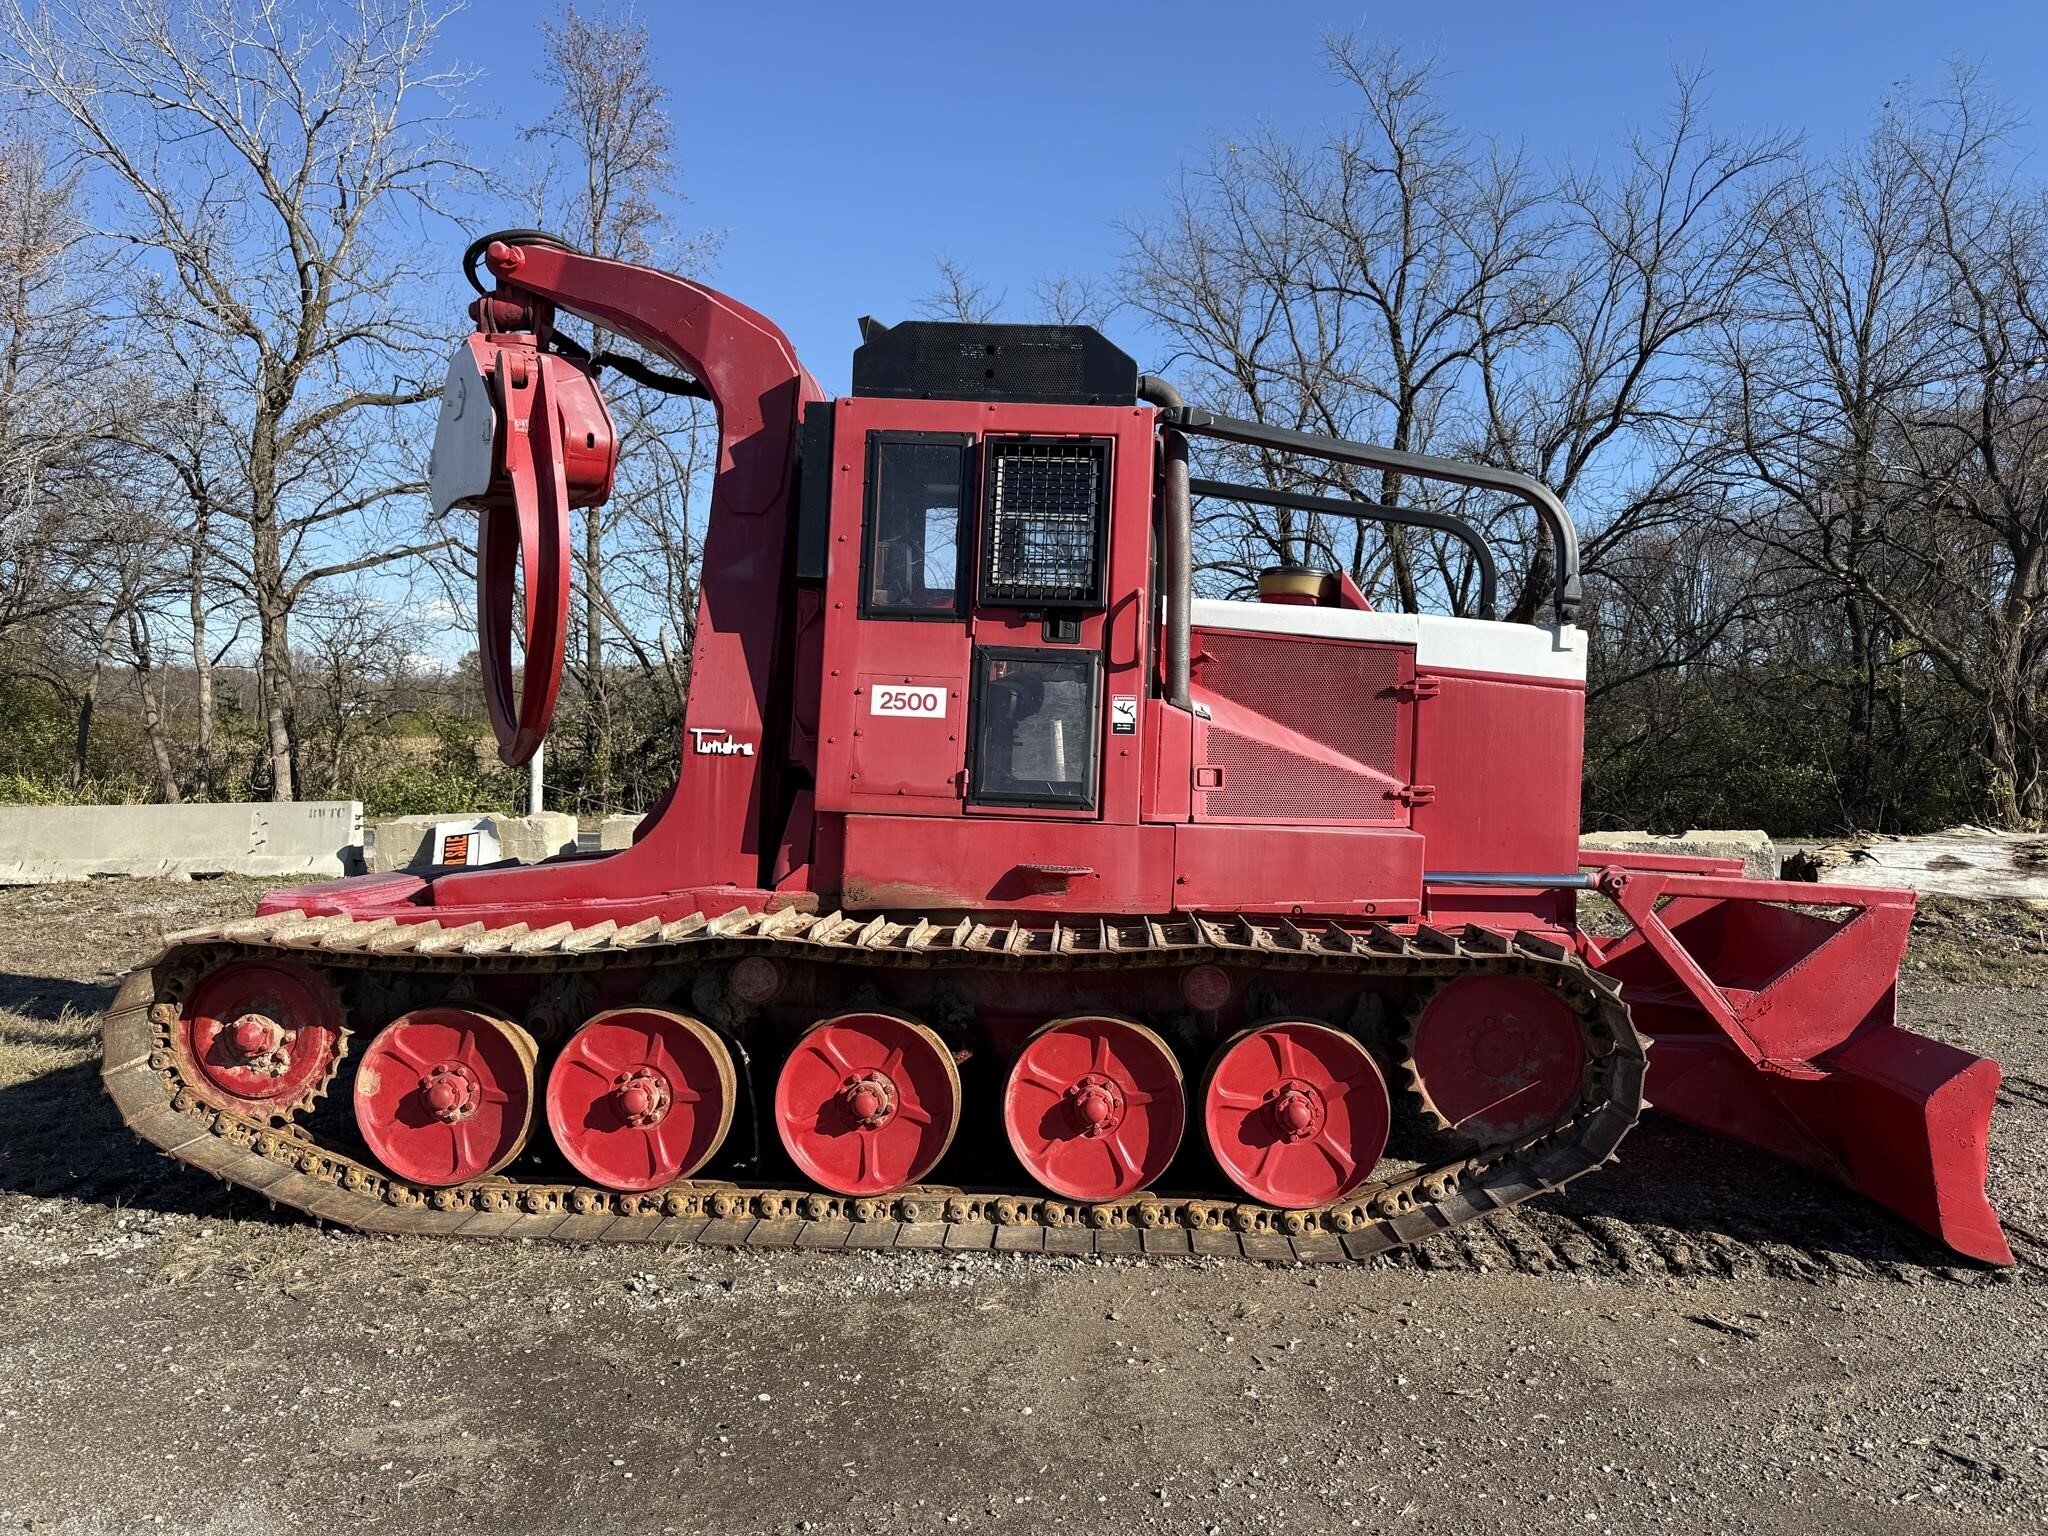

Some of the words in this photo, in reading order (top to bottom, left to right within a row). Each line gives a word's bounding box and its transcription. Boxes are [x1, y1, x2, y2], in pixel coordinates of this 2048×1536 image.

[880, 692, 938, 711] 2500
[689, 728, 755, 755] Tundra
[445, 834, 468, 858] SALE
